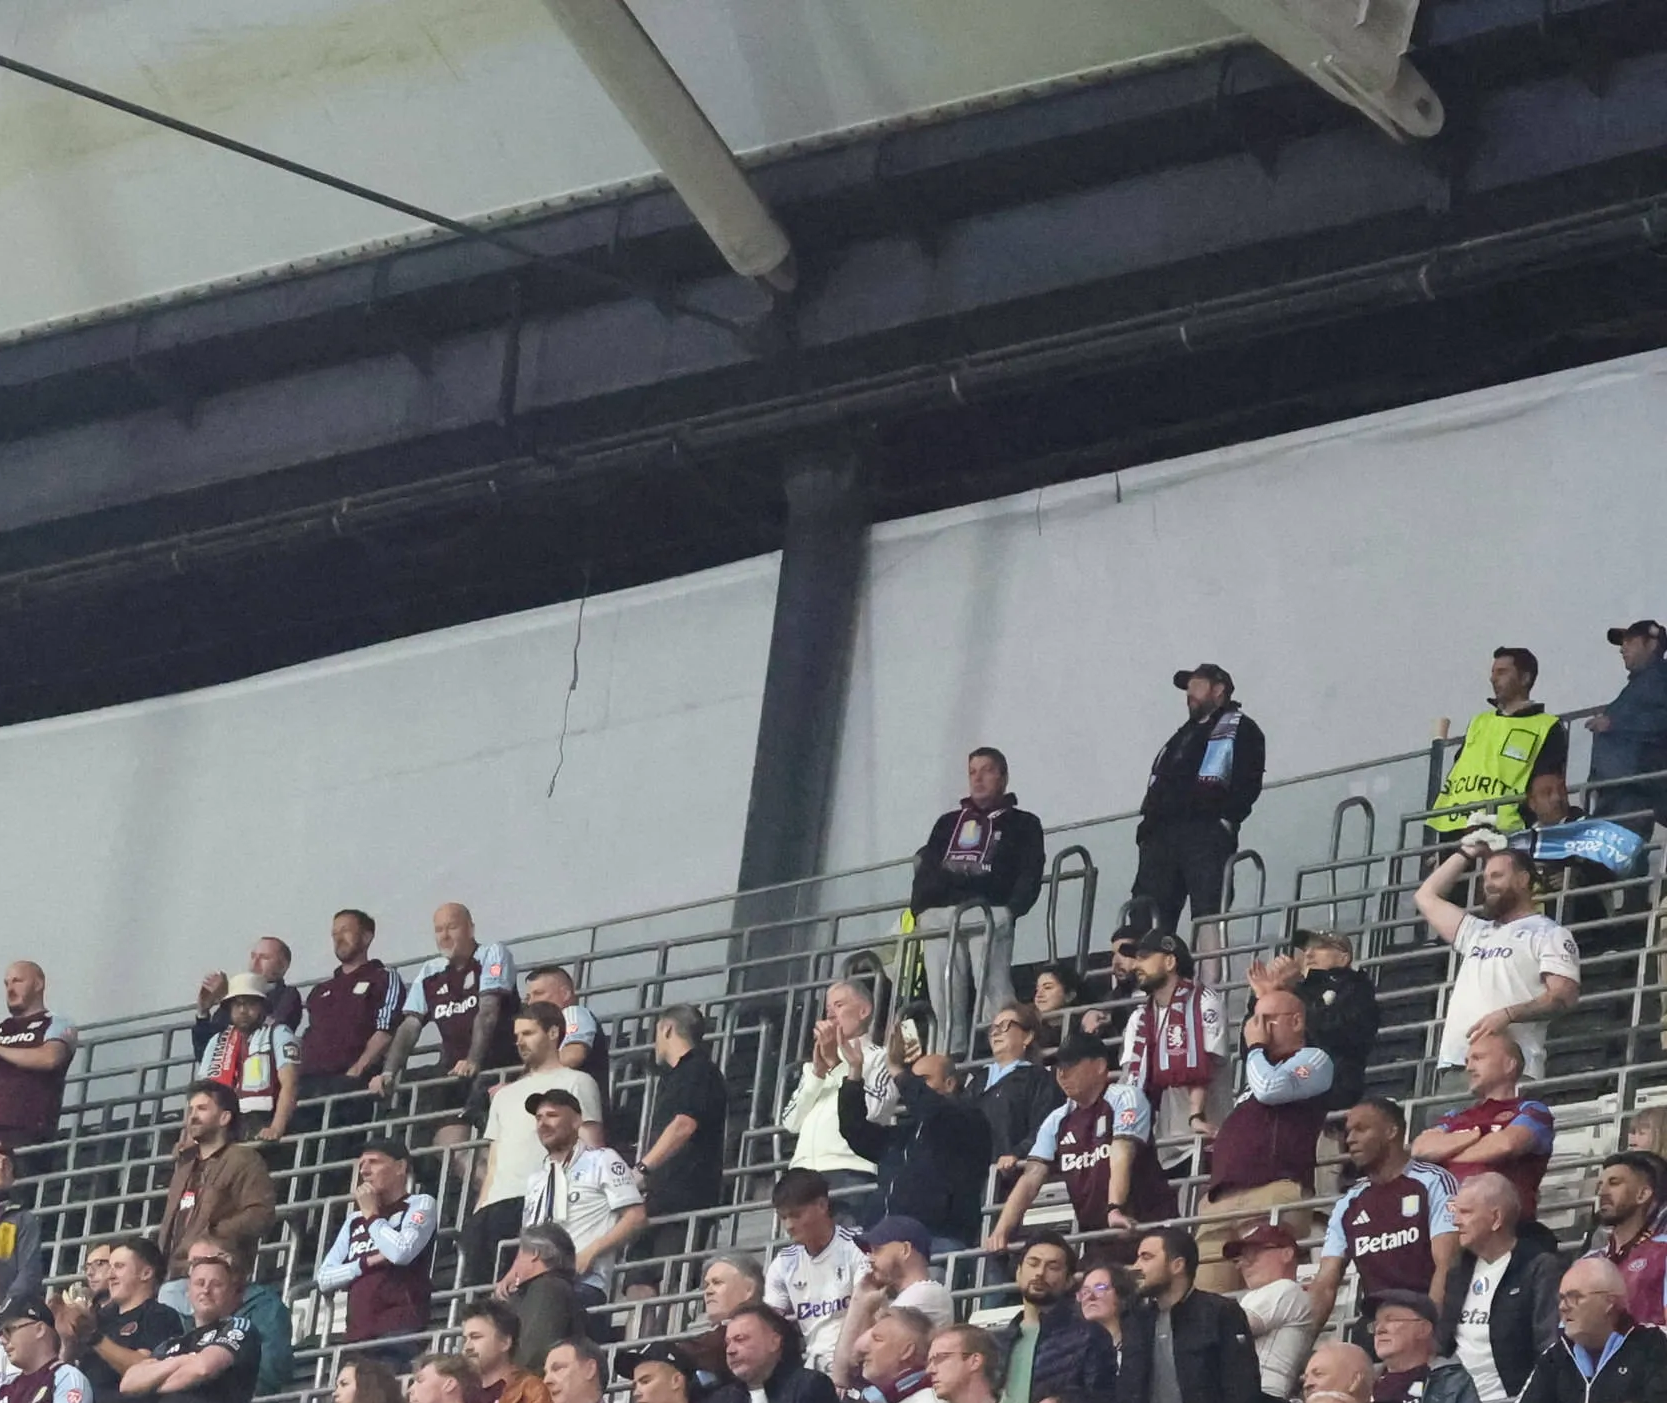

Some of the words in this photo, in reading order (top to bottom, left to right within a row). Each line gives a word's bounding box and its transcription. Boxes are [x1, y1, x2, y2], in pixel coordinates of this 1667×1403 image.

[1441, 775, 1519, 795] SCURIT
[349, 1241, 377, 1260] Bet
[1354, 1226, 1419, 1257] Betano
[1459, 1307, 1490, 1324] eta
